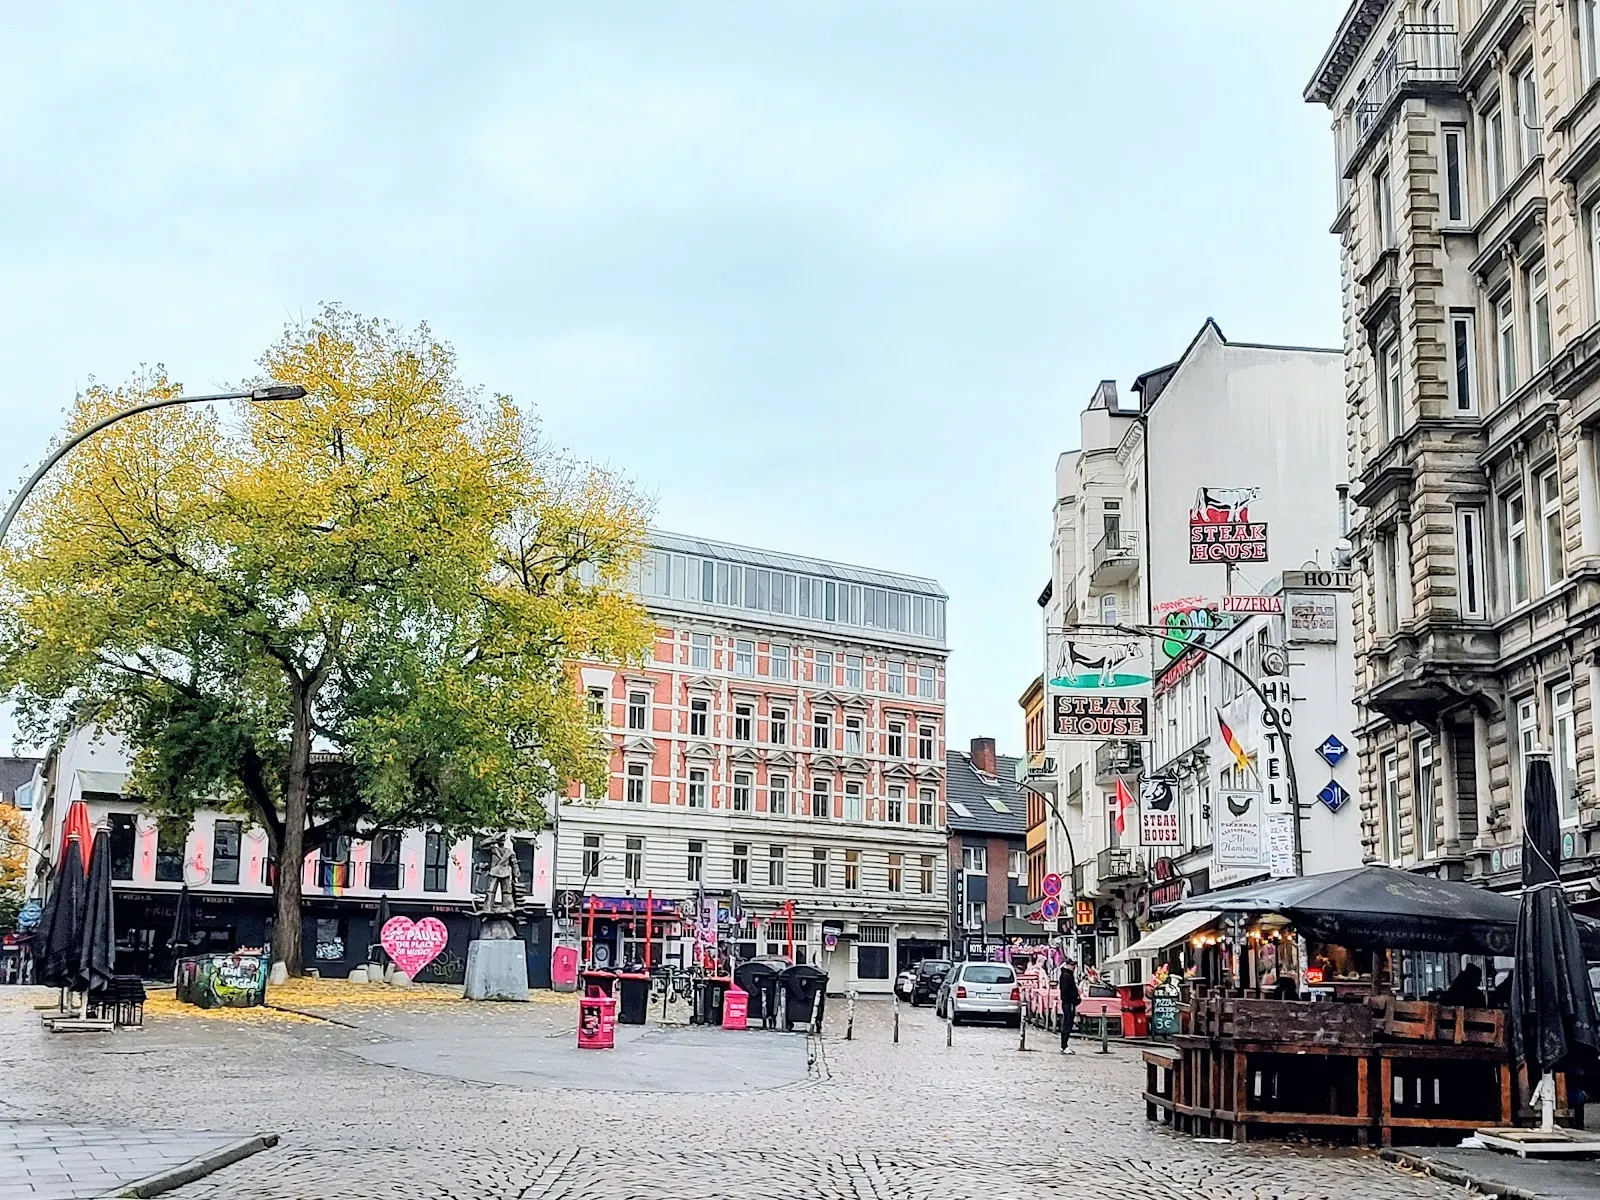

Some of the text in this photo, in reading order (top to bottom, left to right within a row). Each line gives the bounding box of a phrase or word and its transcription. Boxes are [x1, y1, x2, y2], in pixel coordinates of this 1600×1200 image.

[1191, 524, 1266, 542] STEAK
[1191, 543, 1266, 559] HOUSE
[1222, 597, 1282, 612] PIZZERIA
[1058, 697, 1142, 715] STEAK
[1058, 716, 1143, 735] HOUSE
[1143, 814, 1176, 826] STEAK
[1144, 829, 1177, 841] HOUSE
[1221, 842, 1258, 855] Hamburg
[406, 929, 443, 942] PAULI
[406, 948, 431, 956] MUSIC
